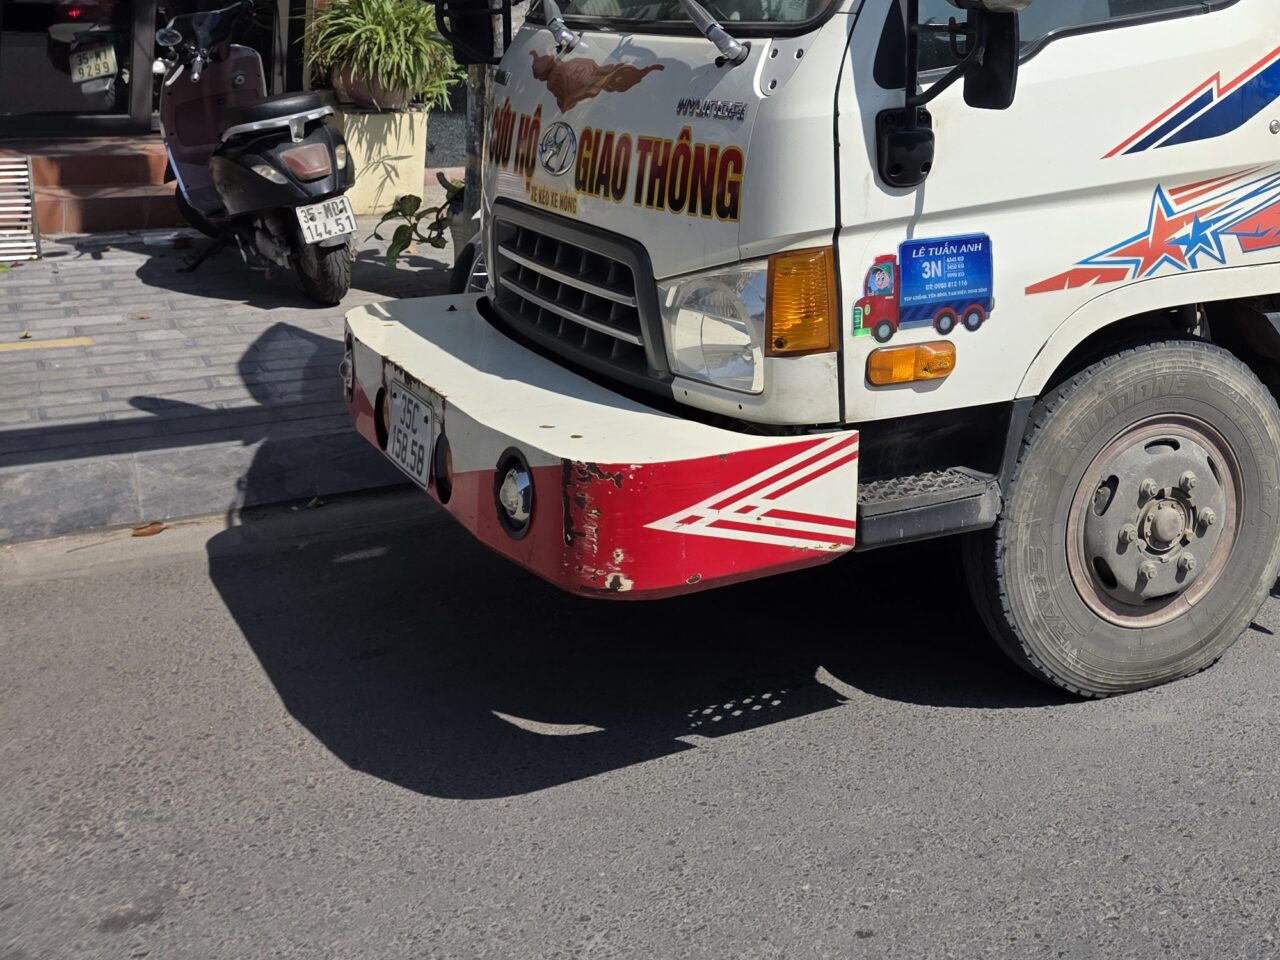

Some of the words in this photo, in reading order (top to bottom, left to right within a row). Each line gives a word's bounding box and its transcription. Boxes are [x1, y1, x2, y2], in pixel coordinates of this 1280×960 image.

[676, 97, 748, 122] HYUNDAI
[574, 126, 632, 204] GIAO
[633, 125, 745, 222] THÔNG
[306, 214, 354, 240] 144.51
[912, 245, 926, 258] LÊ
[928, 242, 958, 257] TUẤN
[959, 243, 983, 253] ANH
[921, 260, 942, 280] 3N
[400, 393, 420, 435] 35C
[391, 423, 425, 477] 158.58
